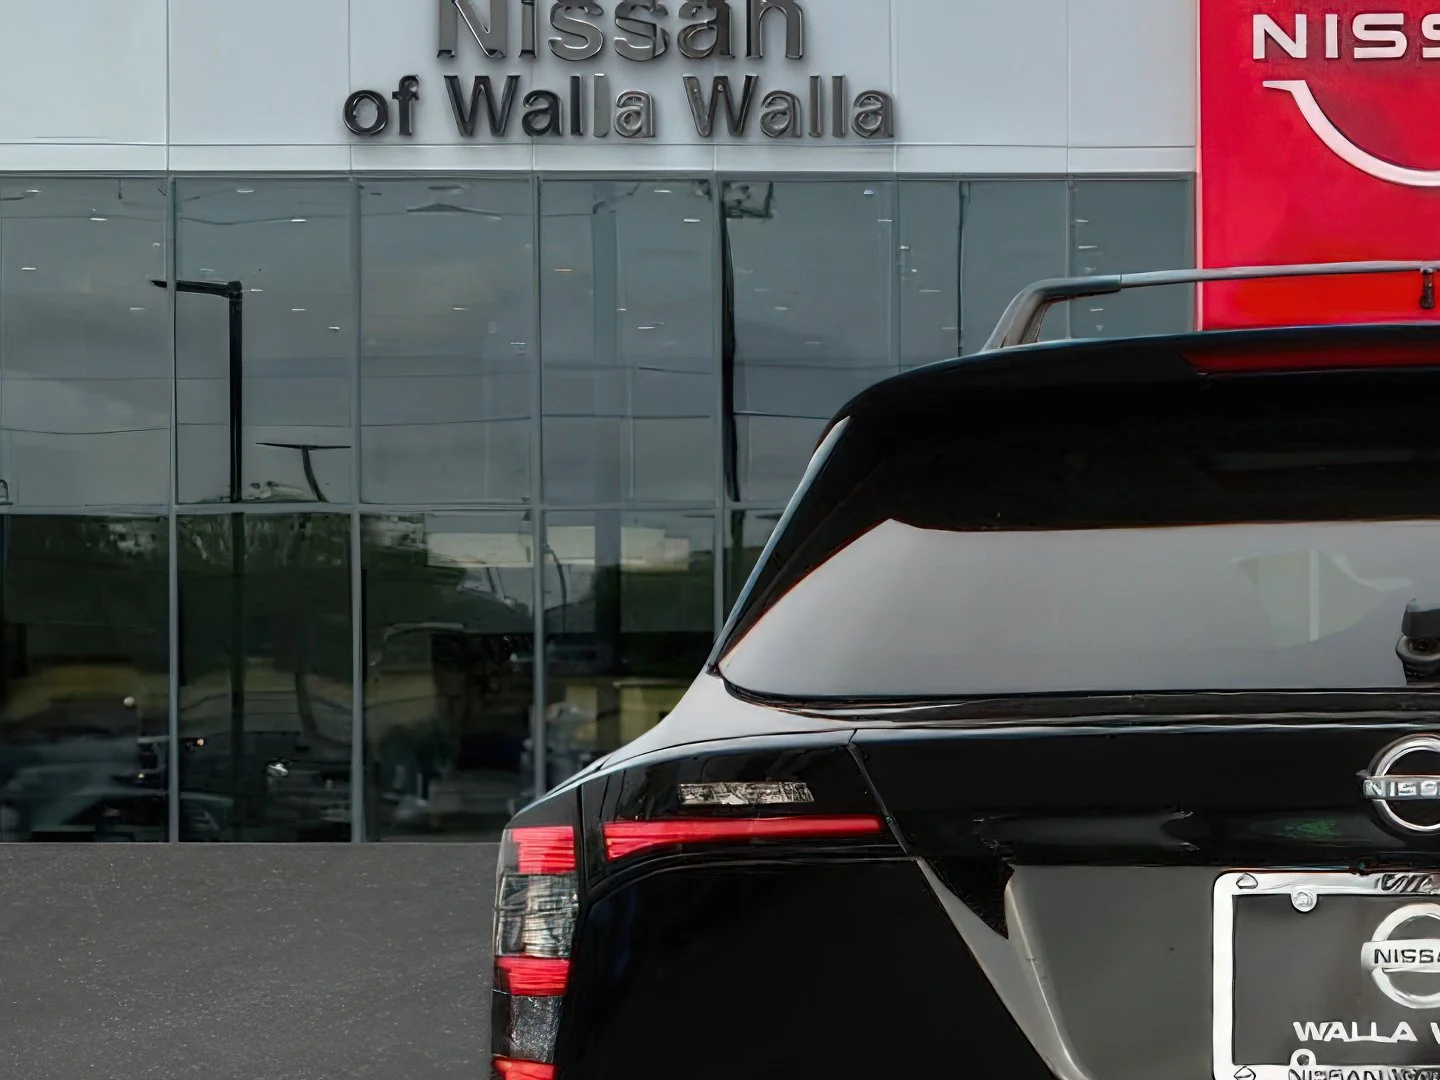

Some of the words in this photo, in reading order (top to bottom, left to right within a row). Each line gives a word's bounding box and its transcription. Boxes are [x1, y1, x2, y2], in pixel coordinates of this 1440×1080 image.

[436, 0, 804, 62] Nissan
[342, 74, 421, 138] of
[443, 74, 657, 138] Walla
[683, 74, 895, 138] Walla
[1292, 1021, 1418, 1044] WALLA
